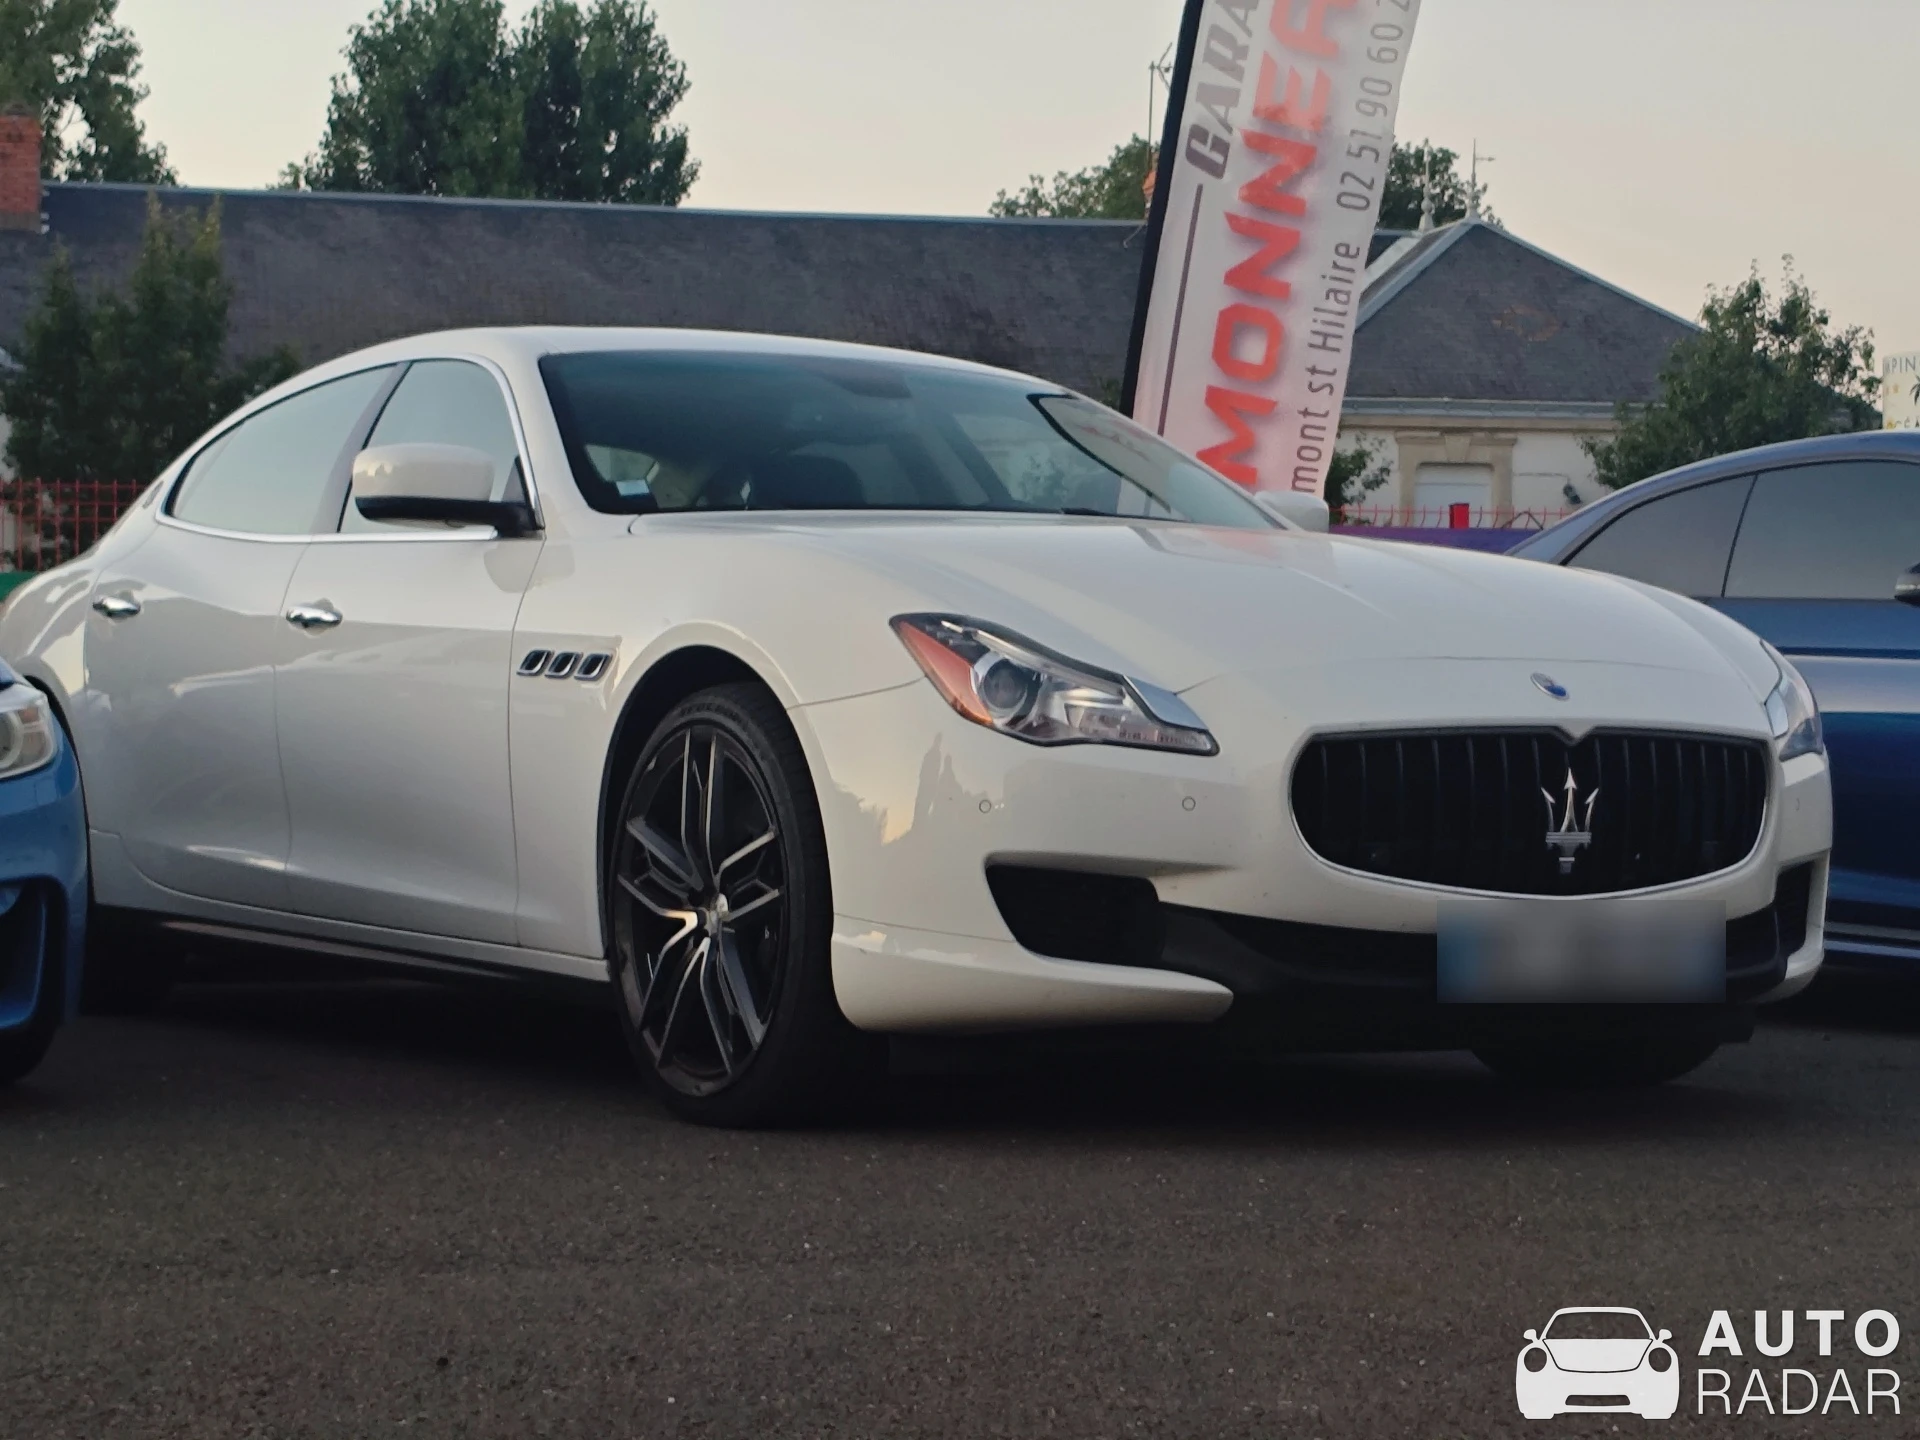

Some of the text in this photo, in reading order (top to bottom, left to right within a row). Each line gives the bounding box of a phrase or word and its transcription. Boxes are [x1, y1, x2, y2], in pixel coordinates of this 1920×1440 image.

[1185, 0, 1260, 180] GARA
[1307, 242, 1360, 353] Hilaire
[1305, 364, 1338, 396] st
[1291, 407, 1329, 493] mont
